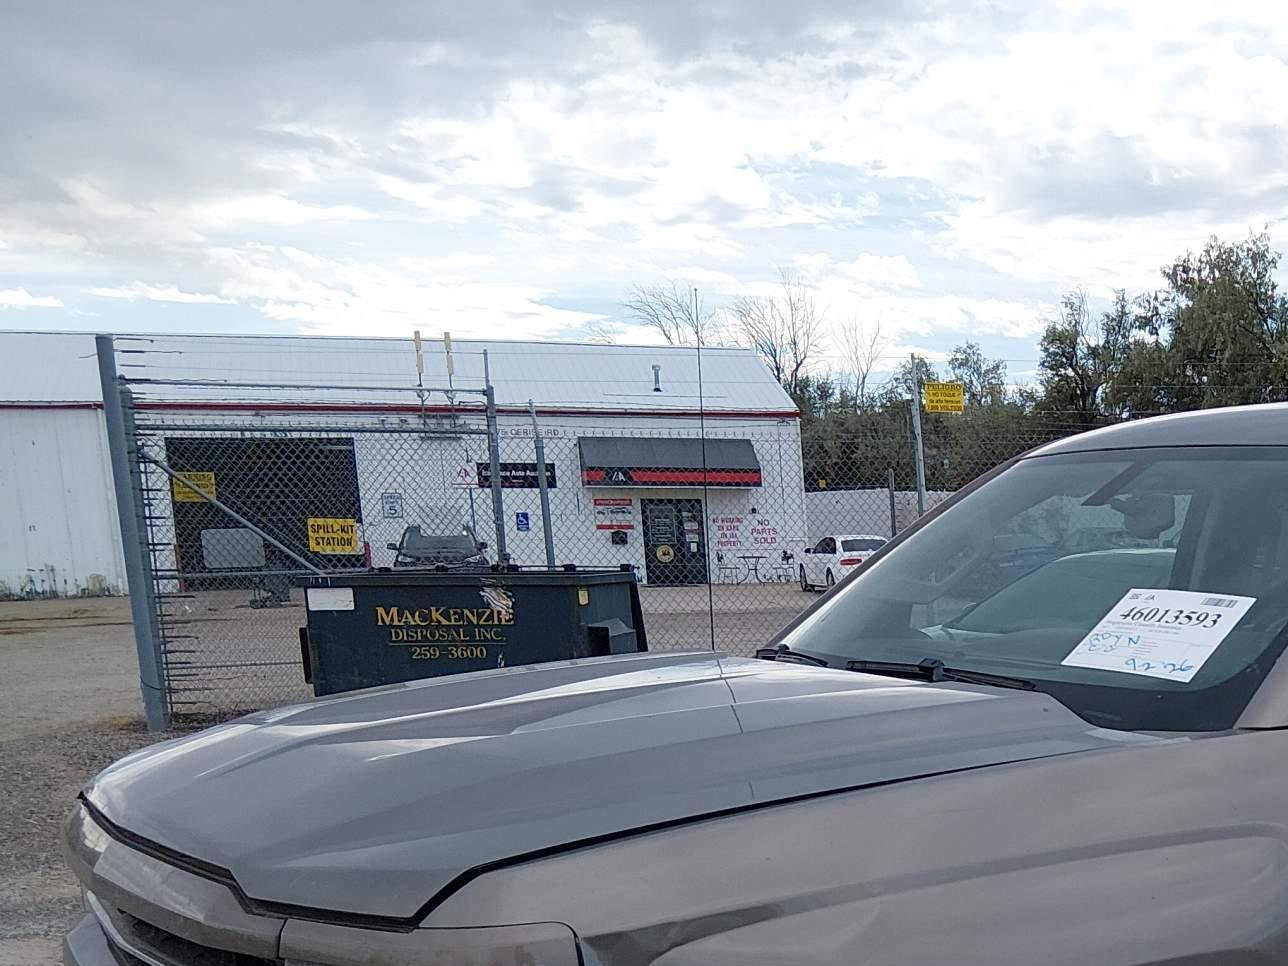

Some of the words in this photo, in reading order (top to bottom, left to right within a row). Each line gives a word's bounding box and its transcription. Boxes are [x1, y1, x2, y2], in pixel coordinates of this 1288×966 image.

[388, 505, 397, 515] 5
[310, 524, 355, 534] SPILL-KIT
[315, 536, 352, 547] STATION
[1120, 606, 1224, 629] 46013593
[391, 628, 470, 641] DISPOSAL
[474, 628, 506, 640] INC.
[411, 646, 487, 659] 259-3600
